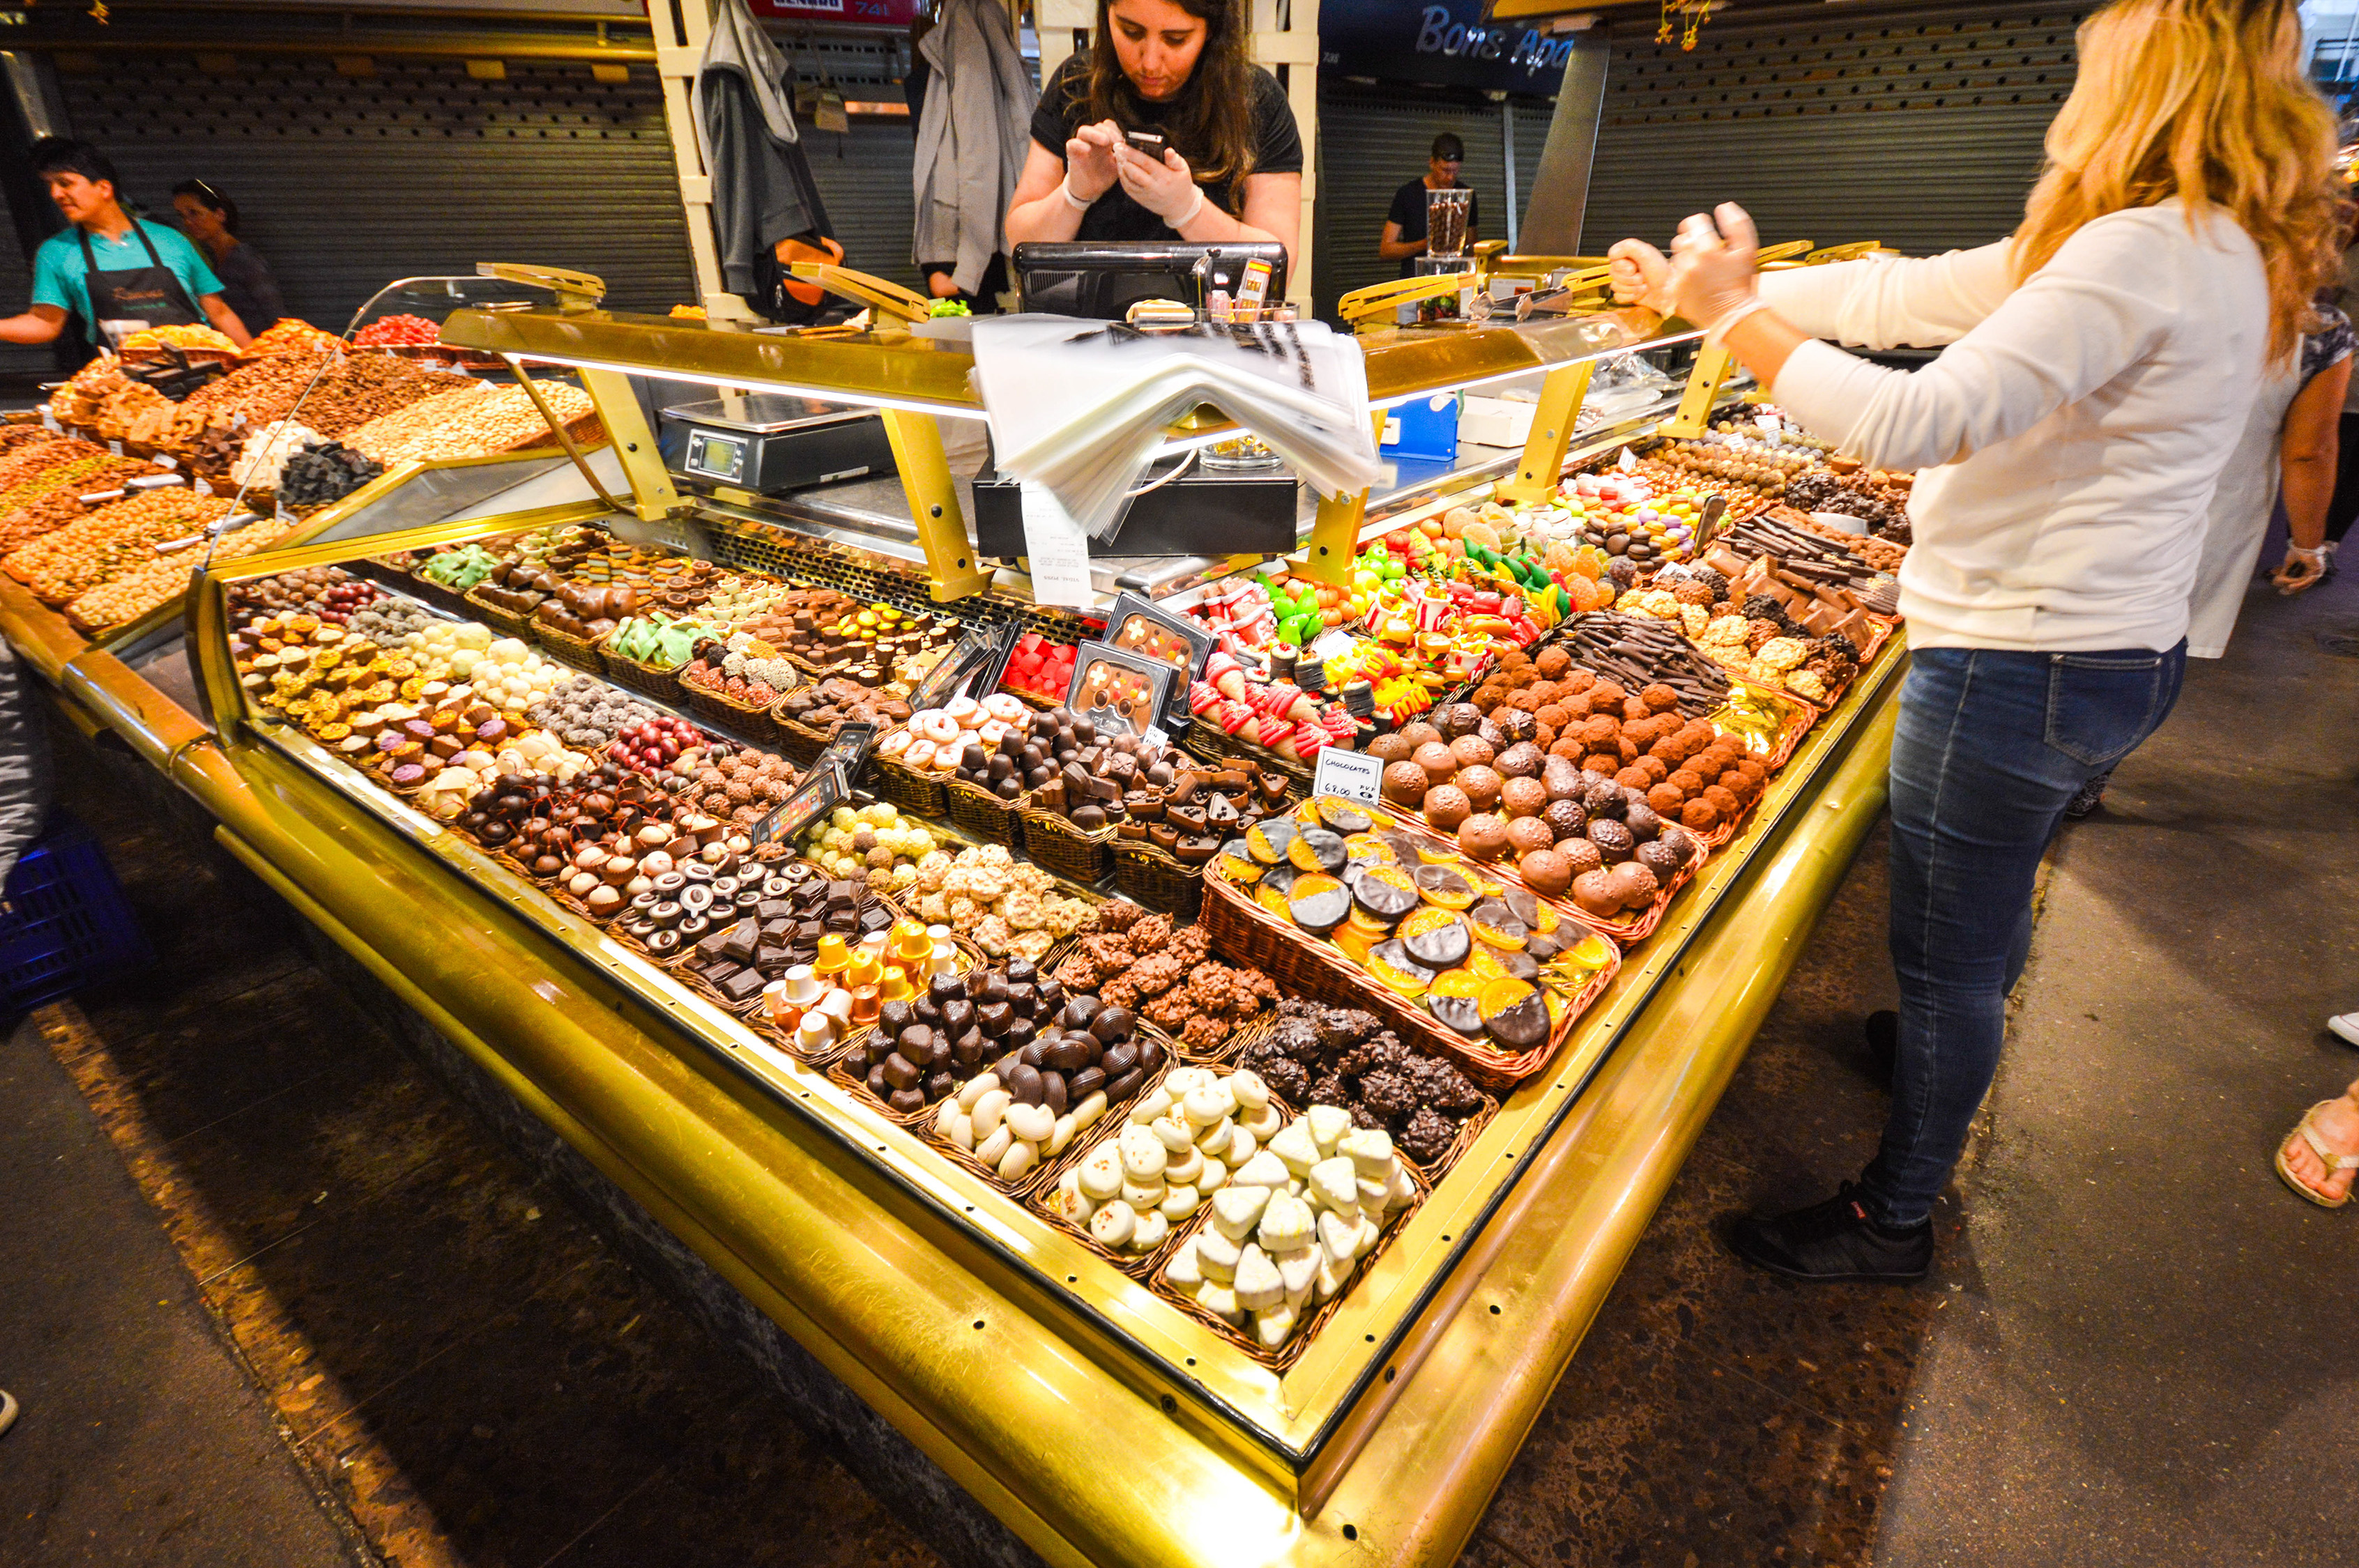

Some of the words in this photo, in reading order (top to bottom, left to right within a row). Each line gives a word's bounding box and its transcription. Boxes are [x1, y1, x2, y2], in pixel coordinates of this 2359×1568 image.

[854, 1, 890, 16] 741
[1416, 4, 1506, 59] Bons
[1325, 758, 1370, 775] CHOCOLATES
